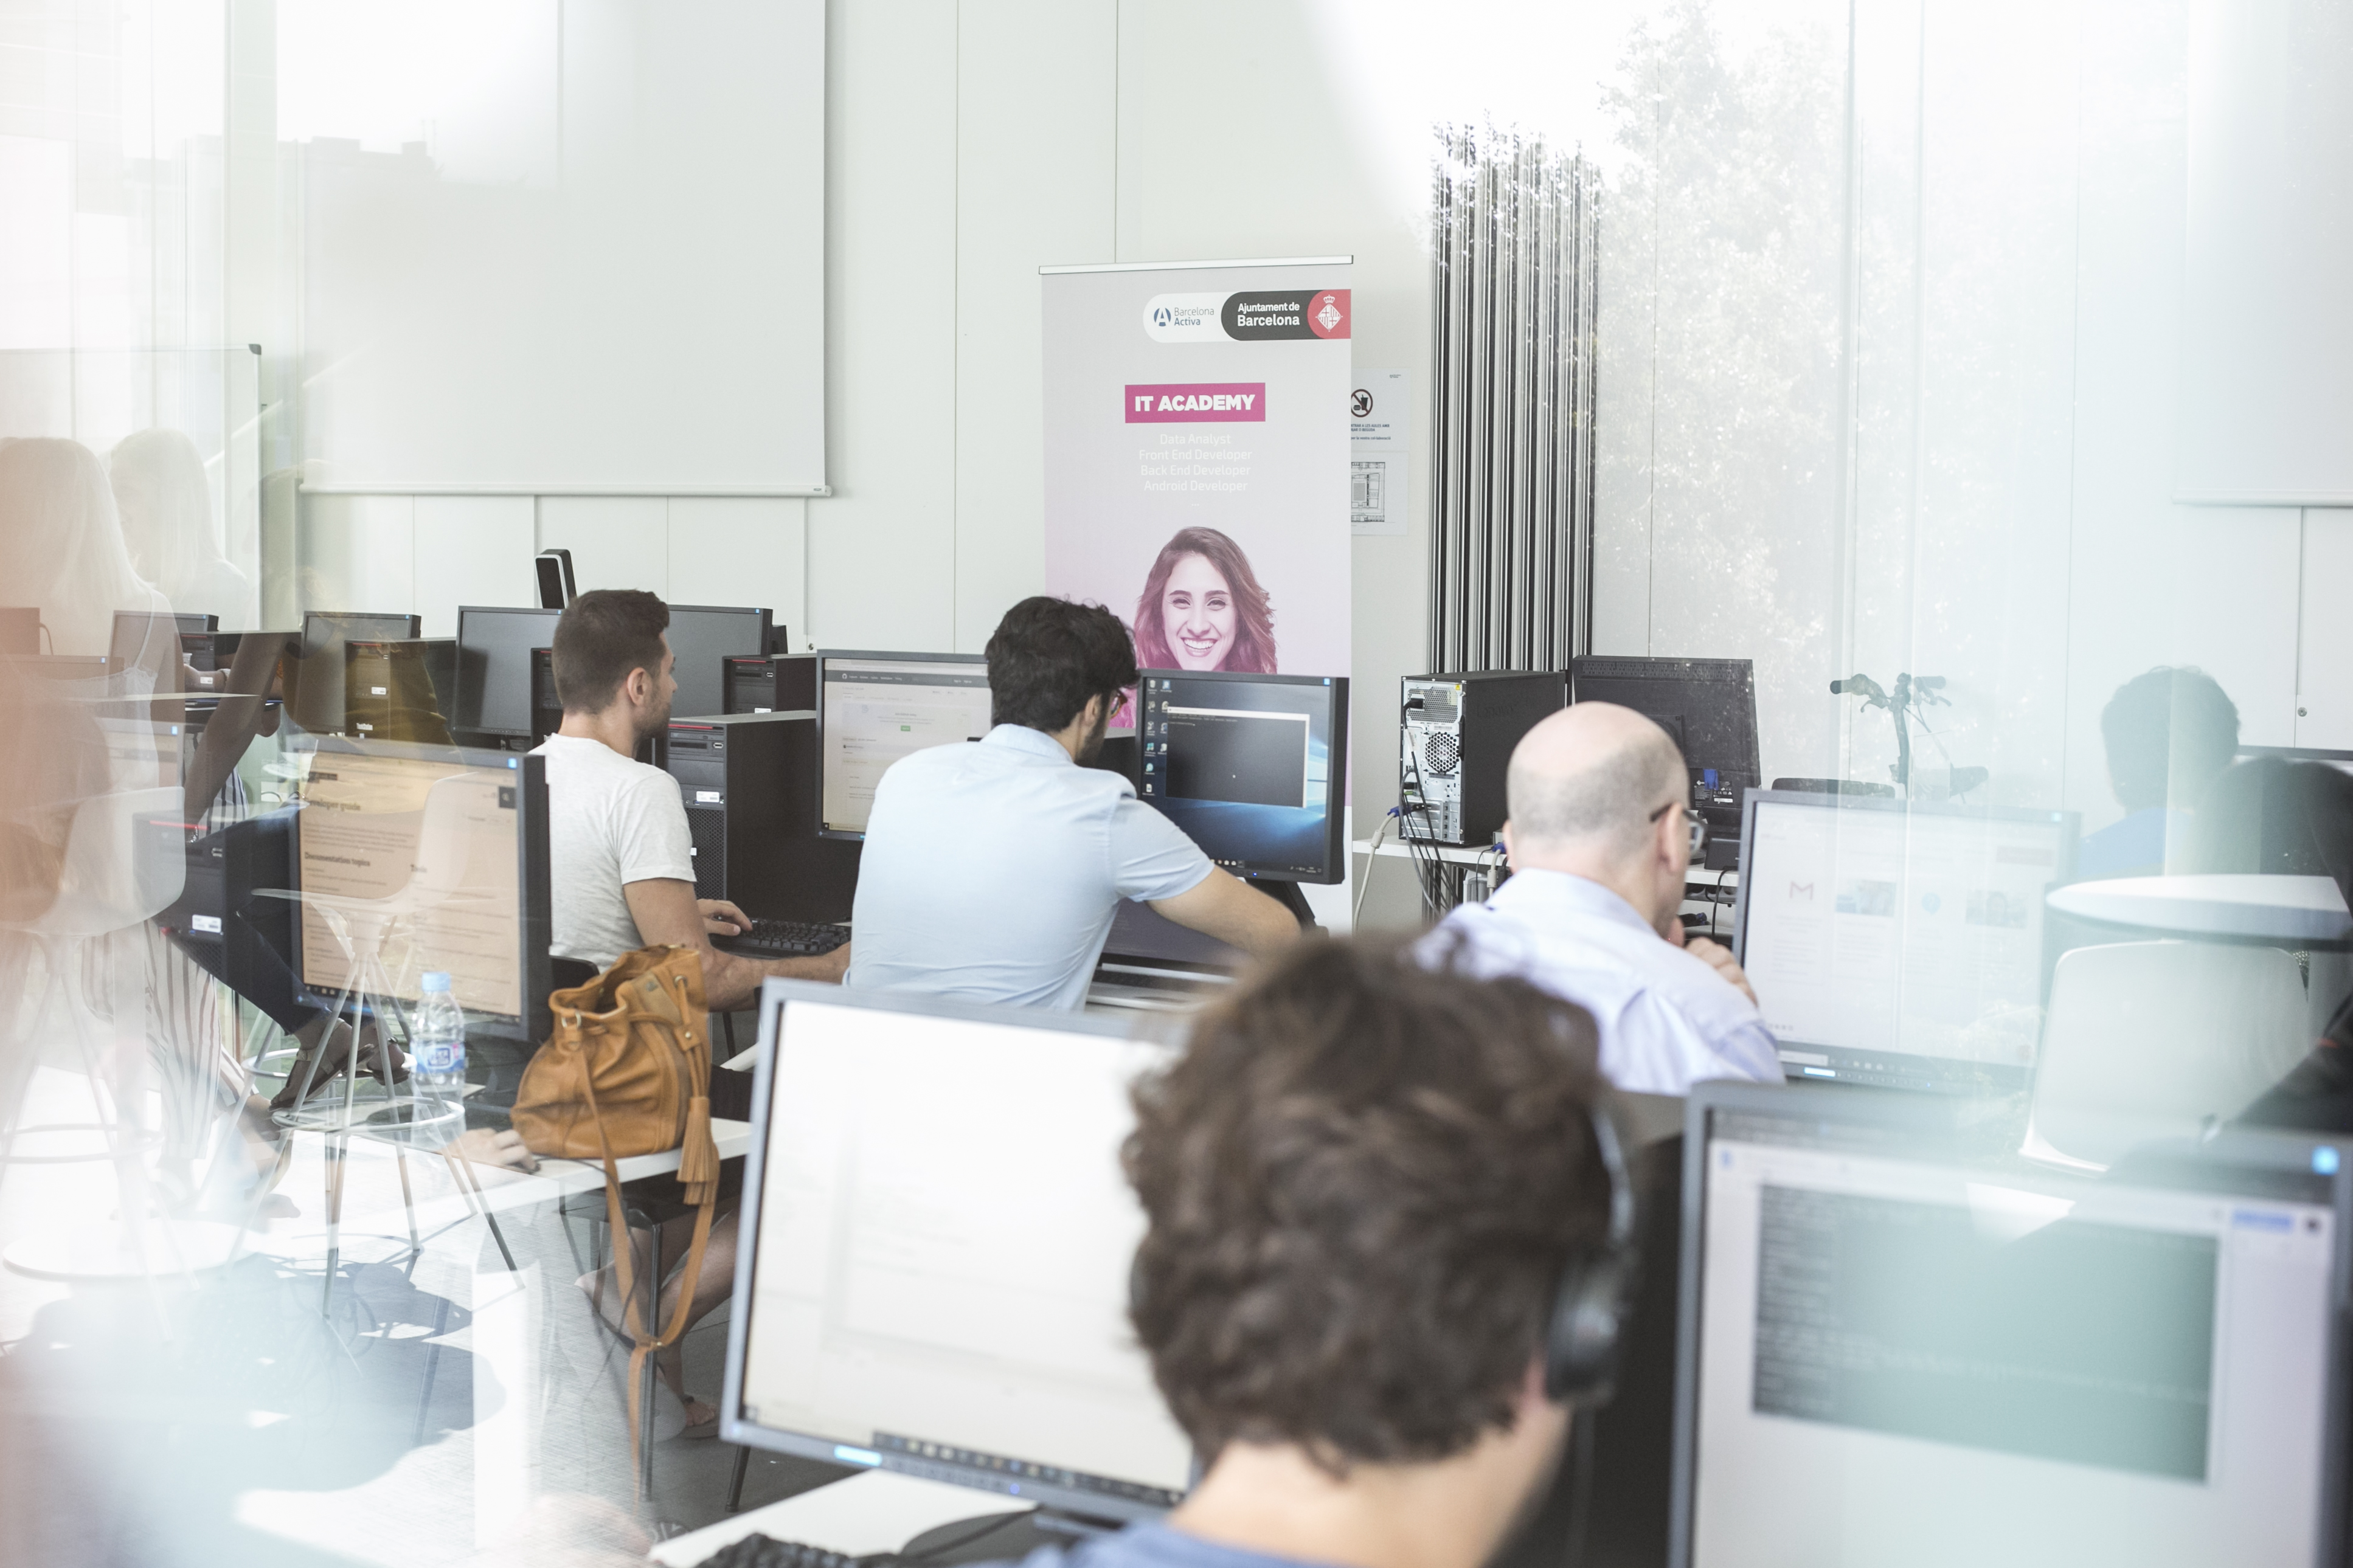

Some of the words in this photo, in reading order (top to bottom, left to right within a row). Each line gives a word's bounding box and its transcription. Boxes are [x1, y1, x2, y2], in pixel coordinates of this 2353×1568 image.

[1174, 307, 1215, 316] Barcelona
[1238, 303, 1287, 315] Ajuntament
[1289, 302, 1300, 311] de
[1174, 317, 1201, 326] Activa
[1238, 314, 1300, 326] Barcelona
[1135, 396, 1154, 412] IT
[1158, 393, 1256, 412] ACADEMY
[1160, 434, 1185, 444] Data
[1188, 433, 1231, 446] Analyst
[1139, 449, 1169, 460] Front
[1172, 449, 1191, 460] End
[1195, 449, 1252, 461] Developer
[1141, 465, 1168, 475] Back
[1171, 465, 1190, 475] End
[1194, 465, 1251, 477] Developer
[1144, 480, 1187, 491] Android
[1191, 480, 1248, 493] Developer
